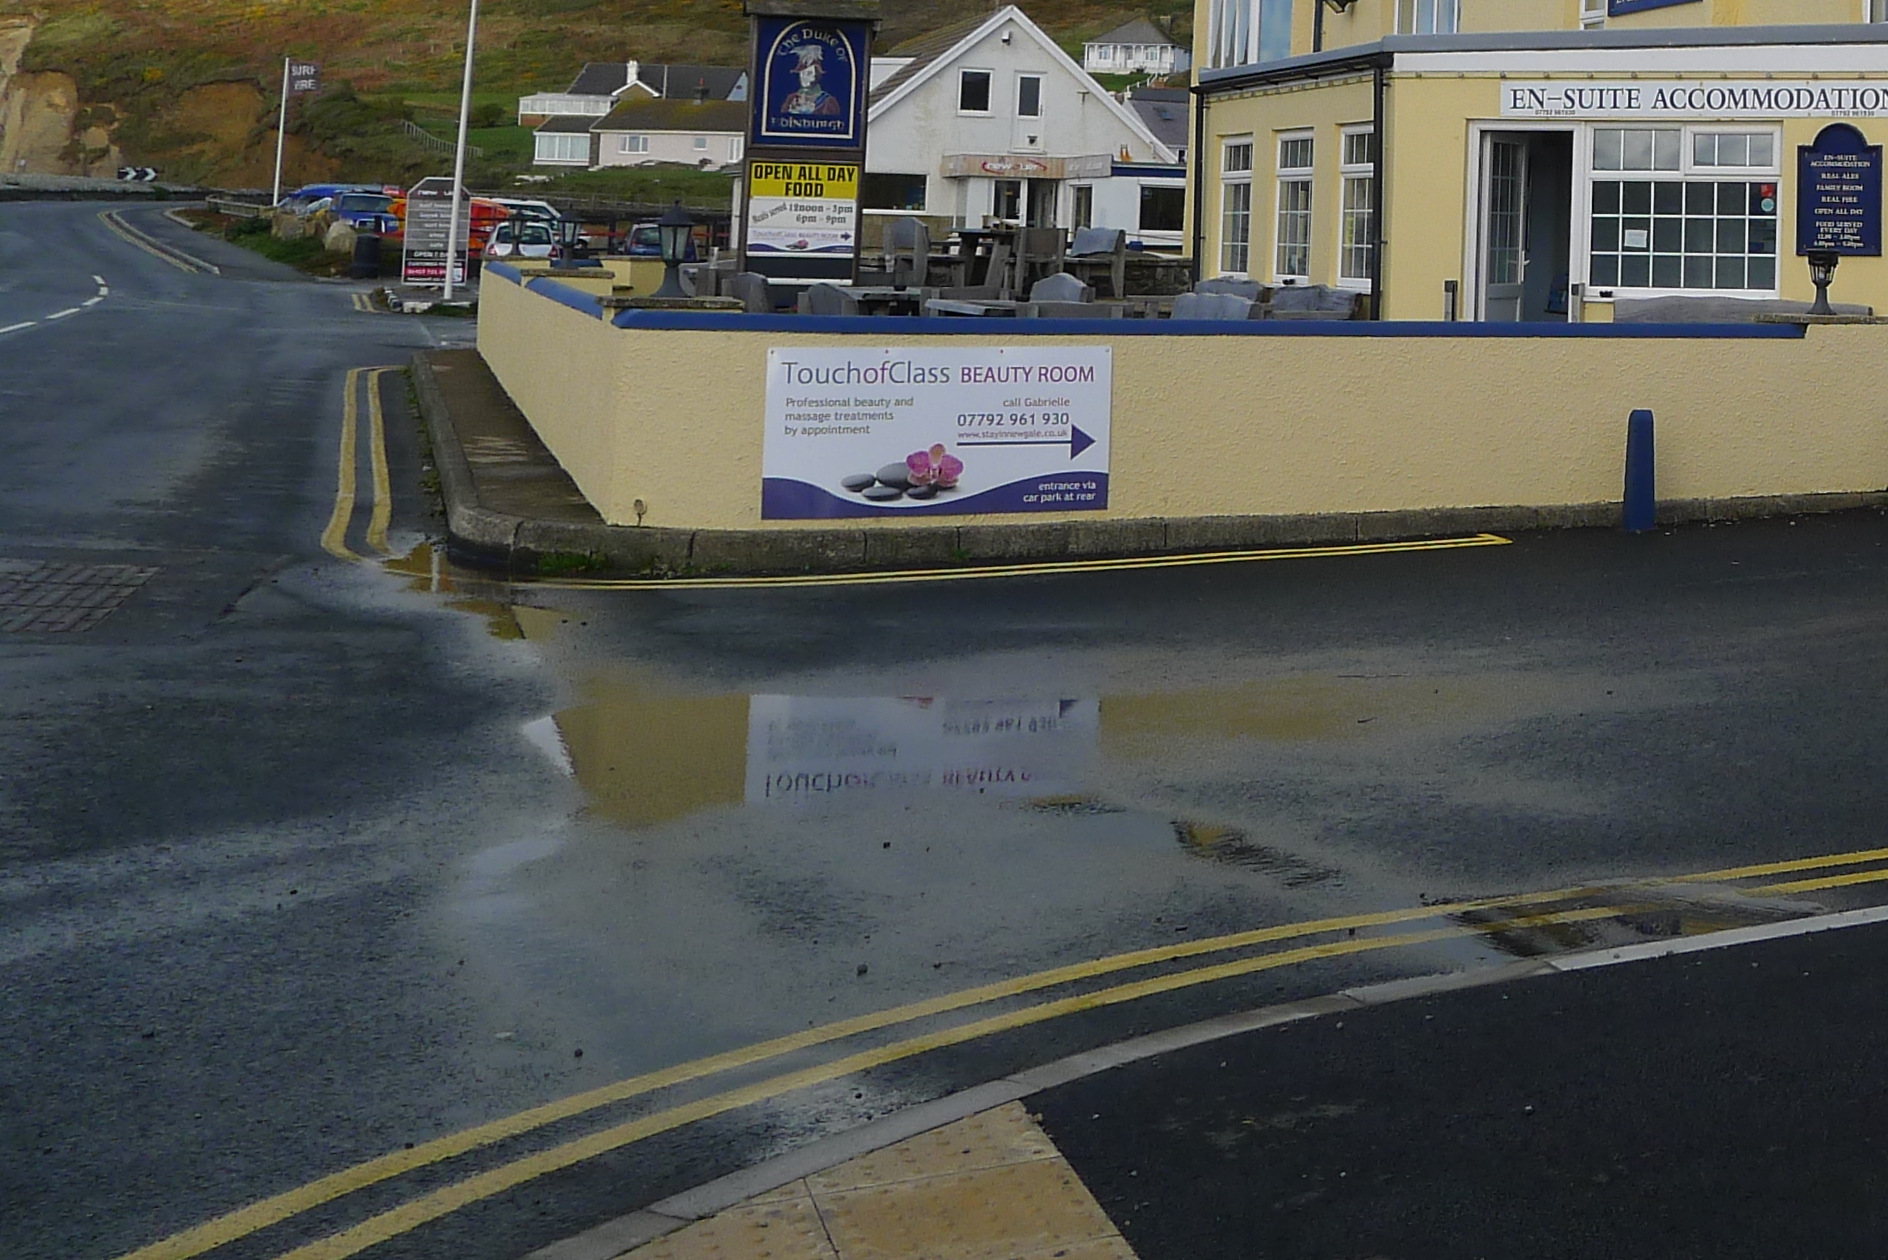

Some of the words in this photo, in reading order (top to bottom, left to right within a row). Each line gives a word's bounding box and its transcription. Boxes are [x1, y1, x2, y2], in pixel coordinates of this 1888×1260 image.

[1509, 88, 1641, 110] EN-SUITE
[754, 164, 792, 180] OPEN
[797, 165, 823, 181] ALL
[826, 166, 856, 182] DAY
[784, 182, 825, 197] FOOD
[789, 203, 824, 213] 12noon
[780, 360, 951, 385] TouchofClass
[960, 366, 1034, 385] BEAUTY
[1037, 365, 1095, 383] ROOM
[786, 397, 850, 408] Professional
[854, 397, 891, 409] beauty
[894, 397, 914, 407] and
[1003, 398, 1021, 407] call
[1024, 397, 1071, 408] Gabrielle
[785, 412, 831, 423] massage
[834, 410, 894, 421] treatments
[957, 413, 1004, 426] 07792
[1009, 413, 1035, 426] 961
[1042, 412, 1070, 425] 930
[784, 425, 798, 436] by
[801, 425, 871, 437] appointment
[1038, 482, 1080, 491] entrance
[1082, 481, 1097, 490] via
[1023, 494, 1039, 502] car
[1040, 492, 1062, 503] park
[1064, 493, 1074, 501] at
[1076, 493, 1097, 501] rear
